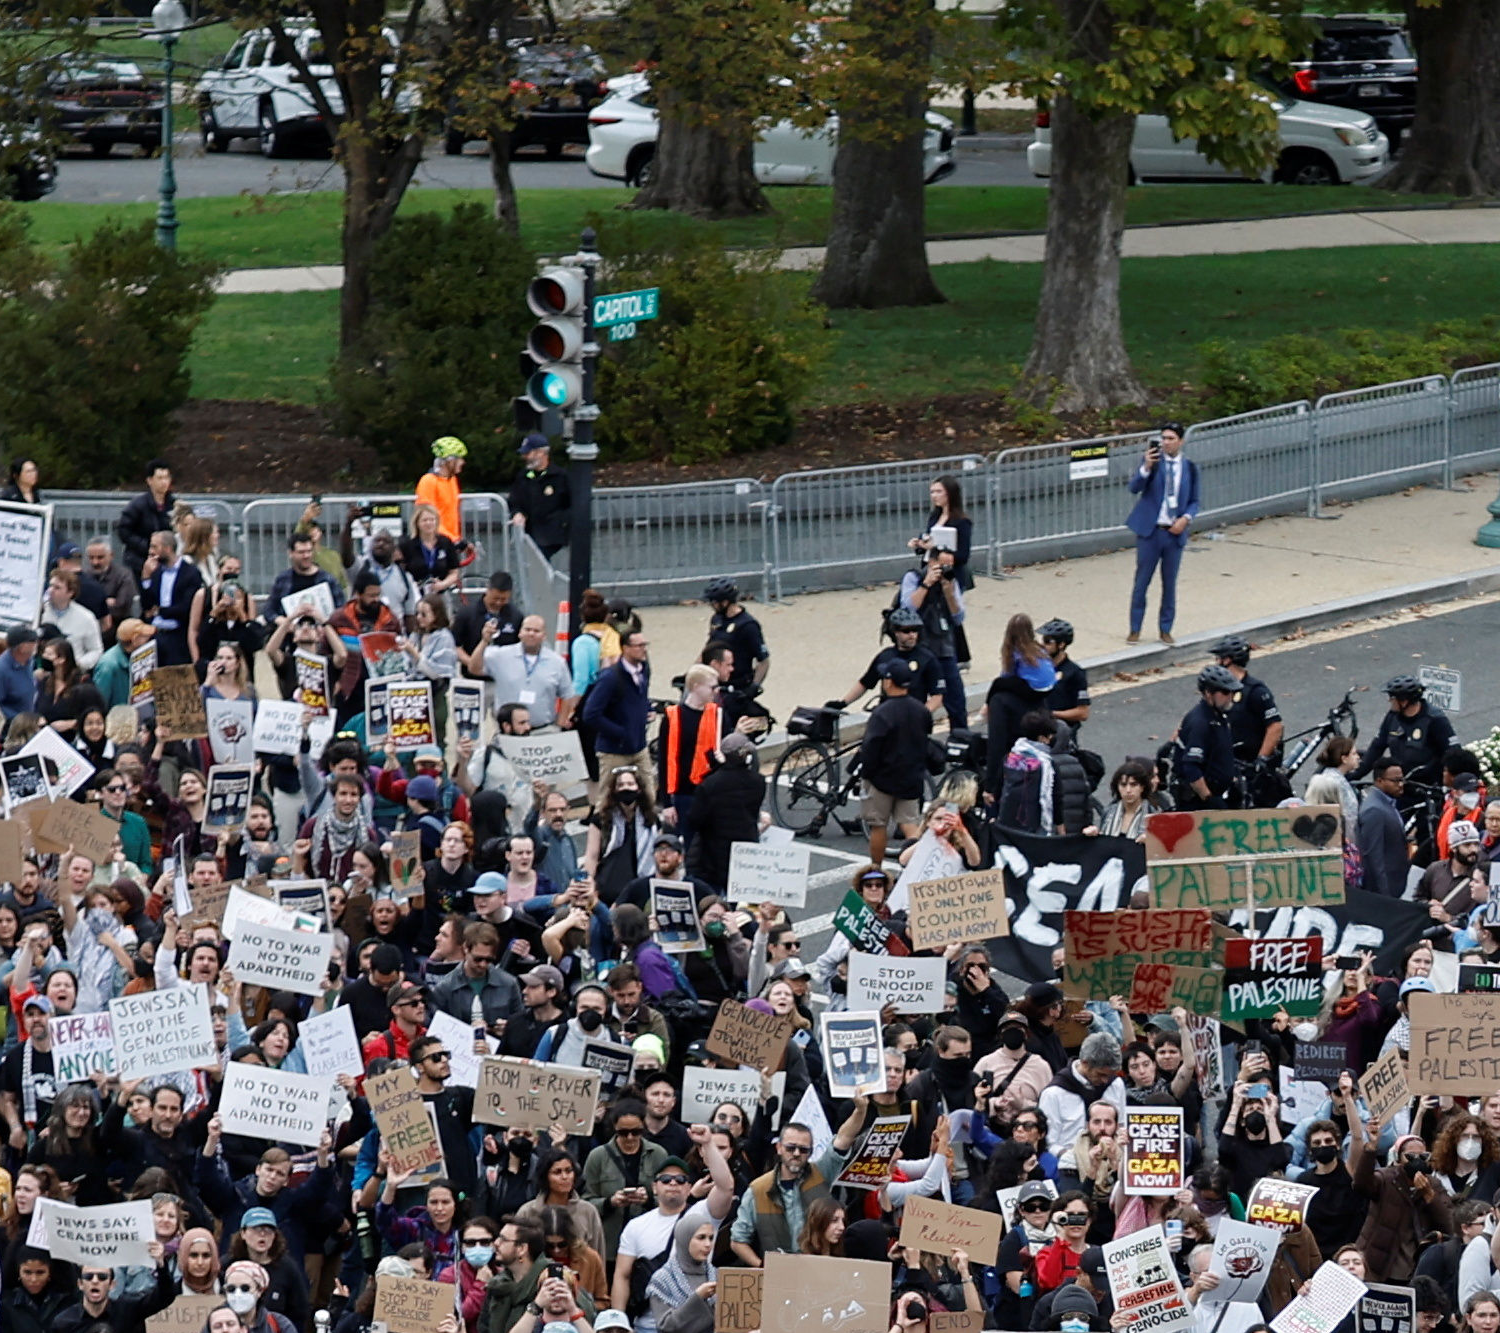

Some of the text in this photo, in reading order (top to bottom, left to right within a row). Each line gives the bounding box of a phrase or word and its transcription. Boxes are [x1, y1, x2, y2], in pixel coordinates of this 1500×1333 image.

[594, 297, 644, 322] CAPITOL
[611, 323, 635, 340] 100
[1199, 817, 1291, 855] FREE
[1152, 856, 1342, 908] PALESTINE
